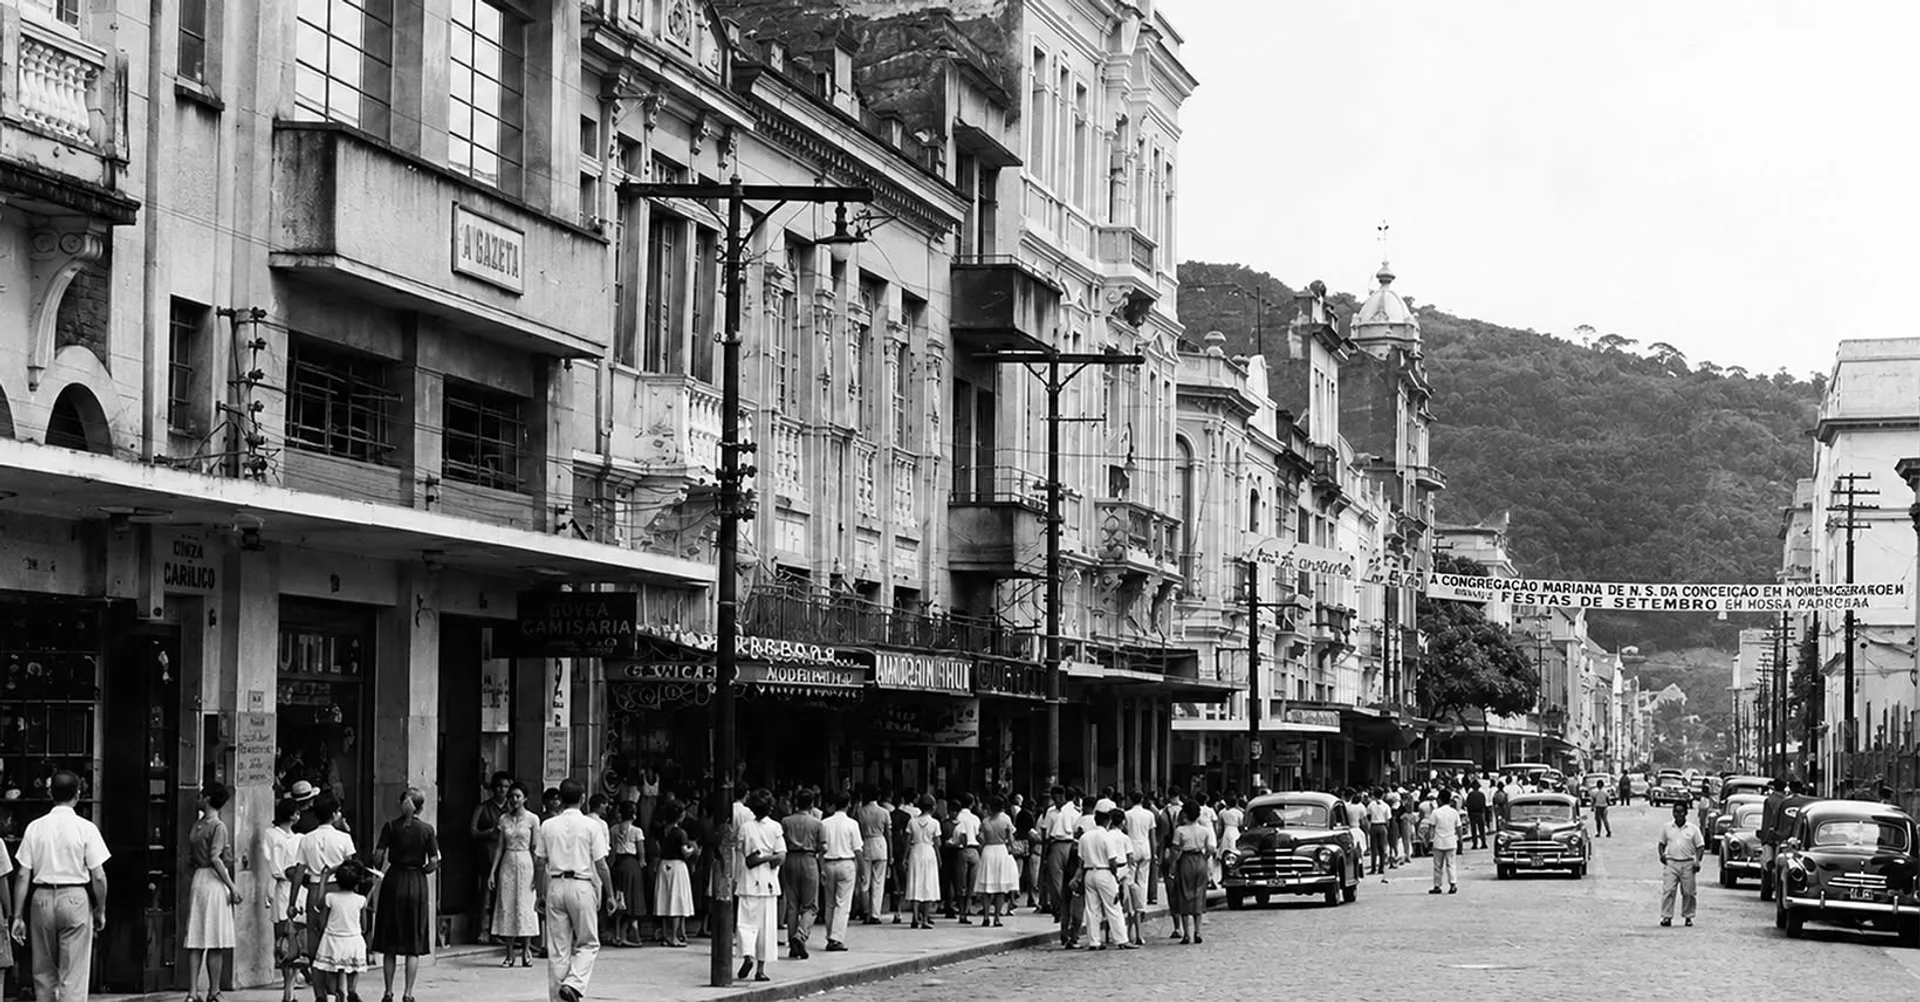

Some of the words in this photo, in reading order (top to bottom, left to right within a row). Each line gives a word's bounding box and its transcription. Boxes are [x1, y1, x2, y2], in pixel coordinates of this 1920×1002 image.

[462, 224, 472, 261] A
[476, 229, 518, 279] GAZETA
[1429, 574, 1438, 585] A
[1542, 581, 1603, 595] MARIANA
[1607, 584, 1625, 596] DE
[1629, 585, 1642, 596] N.
[1645, 585, 1658, 597] S.
[1660, 586, 1678, 597] DA
[1501, 591, 1571, 606] FESTAS
[1580, 595, 1603, 608] DE
[1613, 597, 1717, 610] SETEMBRO
